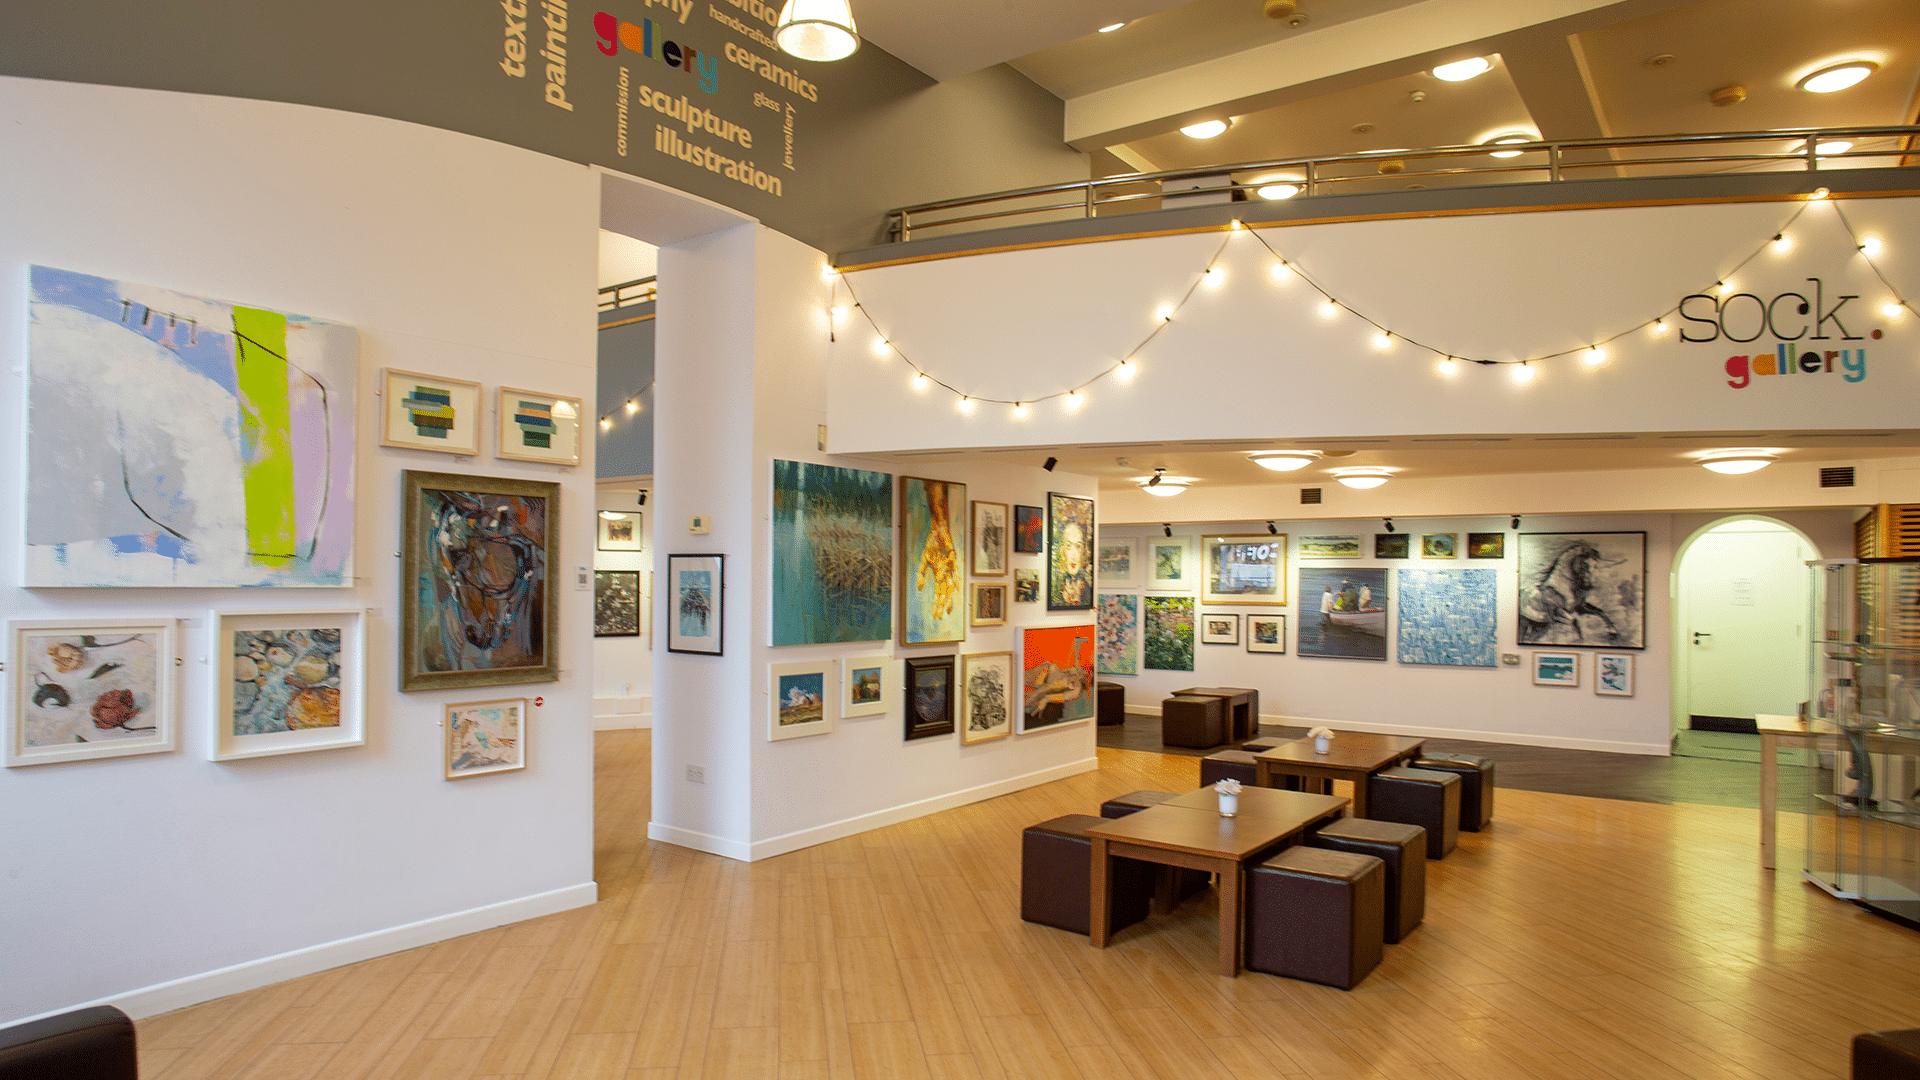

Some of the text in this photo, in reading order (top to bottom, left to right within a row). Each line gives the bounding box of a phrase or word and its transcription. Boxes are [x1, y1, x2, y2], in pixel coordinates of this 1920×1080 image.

[498, 0, 528, 79] text
[593, 11, 718, 94] gallery
[724, 41, 818, 103] ceramics
[616, 66, 630, 157] commission
[638, 84, 753, 149] sculpture
[753, 91, 781, 113] glass
[655, 123, 783, 198] illustration
[782, 102, 797, 172] jewellery
[1678, 277, 1883, 343] sock.
[1724, 342, 1867, 389] gallery
